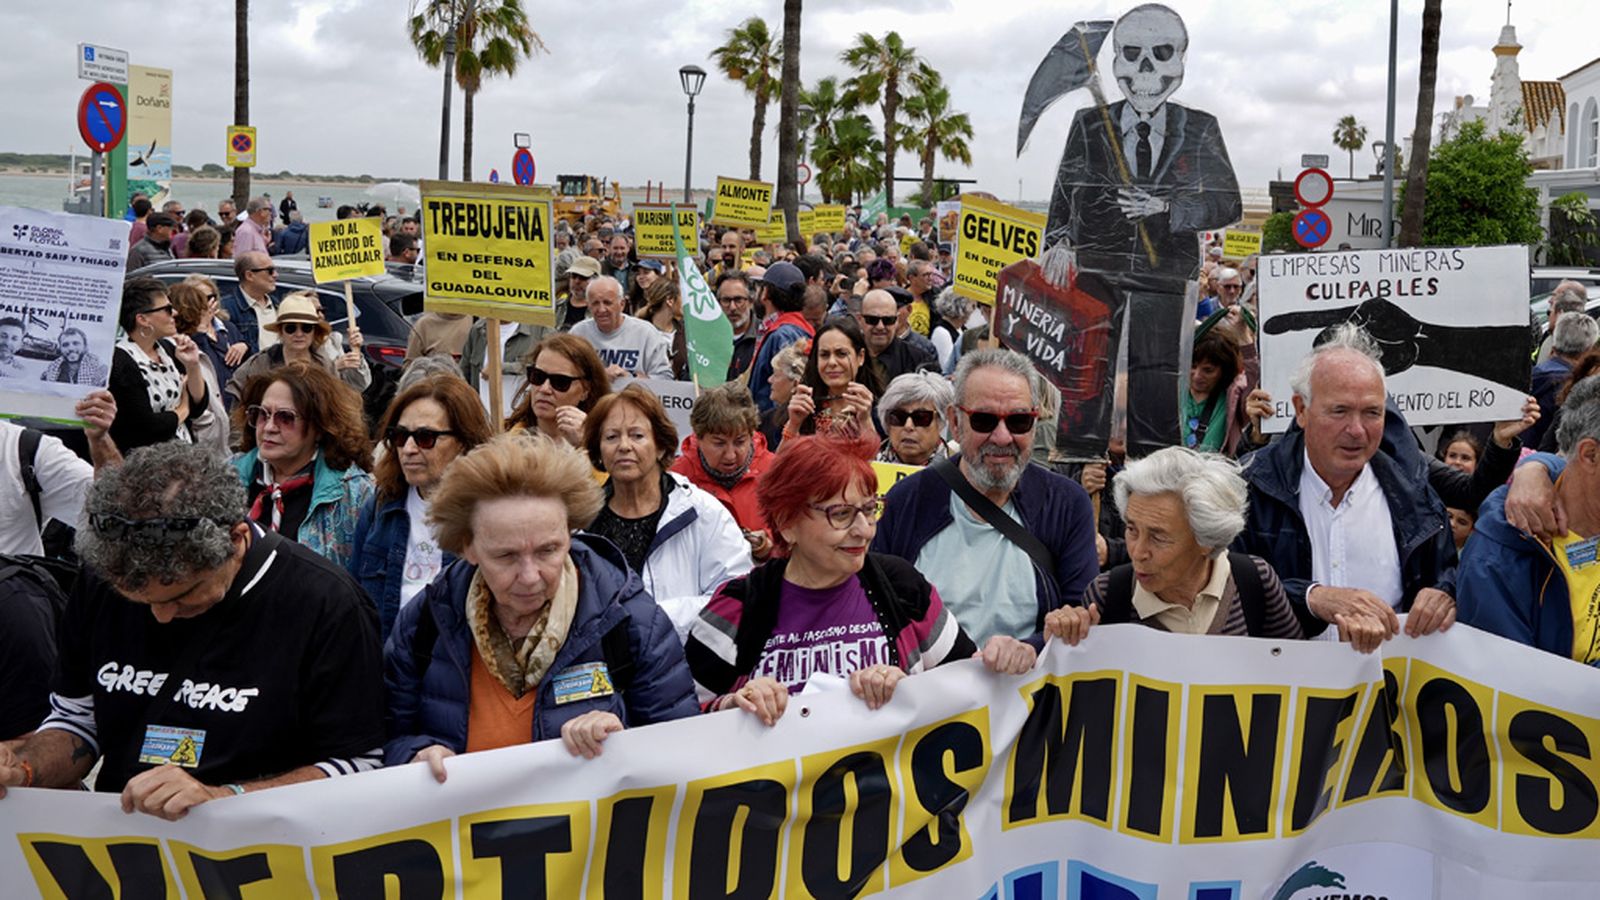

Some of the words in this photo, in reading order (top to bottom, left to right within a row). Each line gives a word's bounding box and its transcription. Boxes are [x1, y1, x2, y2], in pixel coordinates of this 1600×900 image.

[136, 95, 170, 108] Doñana
[720, 184, 769, 202] ALMONTE
[331, 223, 345, 236] NO
[348, 222, 359, 234] AL
[428, 201, 544, 242] TREBUJENA
[637, 212, 694, 227] MARISMLAS
[317, 237, 359, 253] VERTIDO
[362, 235, 375, 248] DE
[963, 213, 1038, 258] GELVES
[0, 246, 43, 258] BERTAD
[45, 252, 69, 261] SAIF
[79, 257, 119, 268] THIAGO
[437, 252, 458, 262] EN
[463, 254, 535, 268] DEFENSA
[965, 251, 979, 262] EN
[1270, 254, 1360, 278] EMPRESAS
[472, 269, 502, 280] DEL
[431, 282, 549, 301] GUADALQUIVIR
[1305, 277, 1439, 300] CULPABLES
[69, 312, 104, 323] LIBRE
[1007, 313, 1021, 335] Y
[1026, 333, 1065, 372] VIDA
[597, 349, 639, 368] ANTS
[658, 395, 693, 410] ERO
[1275, 402, 1293, 418] EL
[1391, 391, 1434, 412] ENTO
[1438, 391, 1463, 409] DEL
[1468, 387, 1495, 409] RÍO
[787, 632, 801, 643] AL
[803, 624, 847, 641] FASCISMO
[848, 621, 883, 634] DESATA
[1009, 667, 1600, 835] MINEROS
